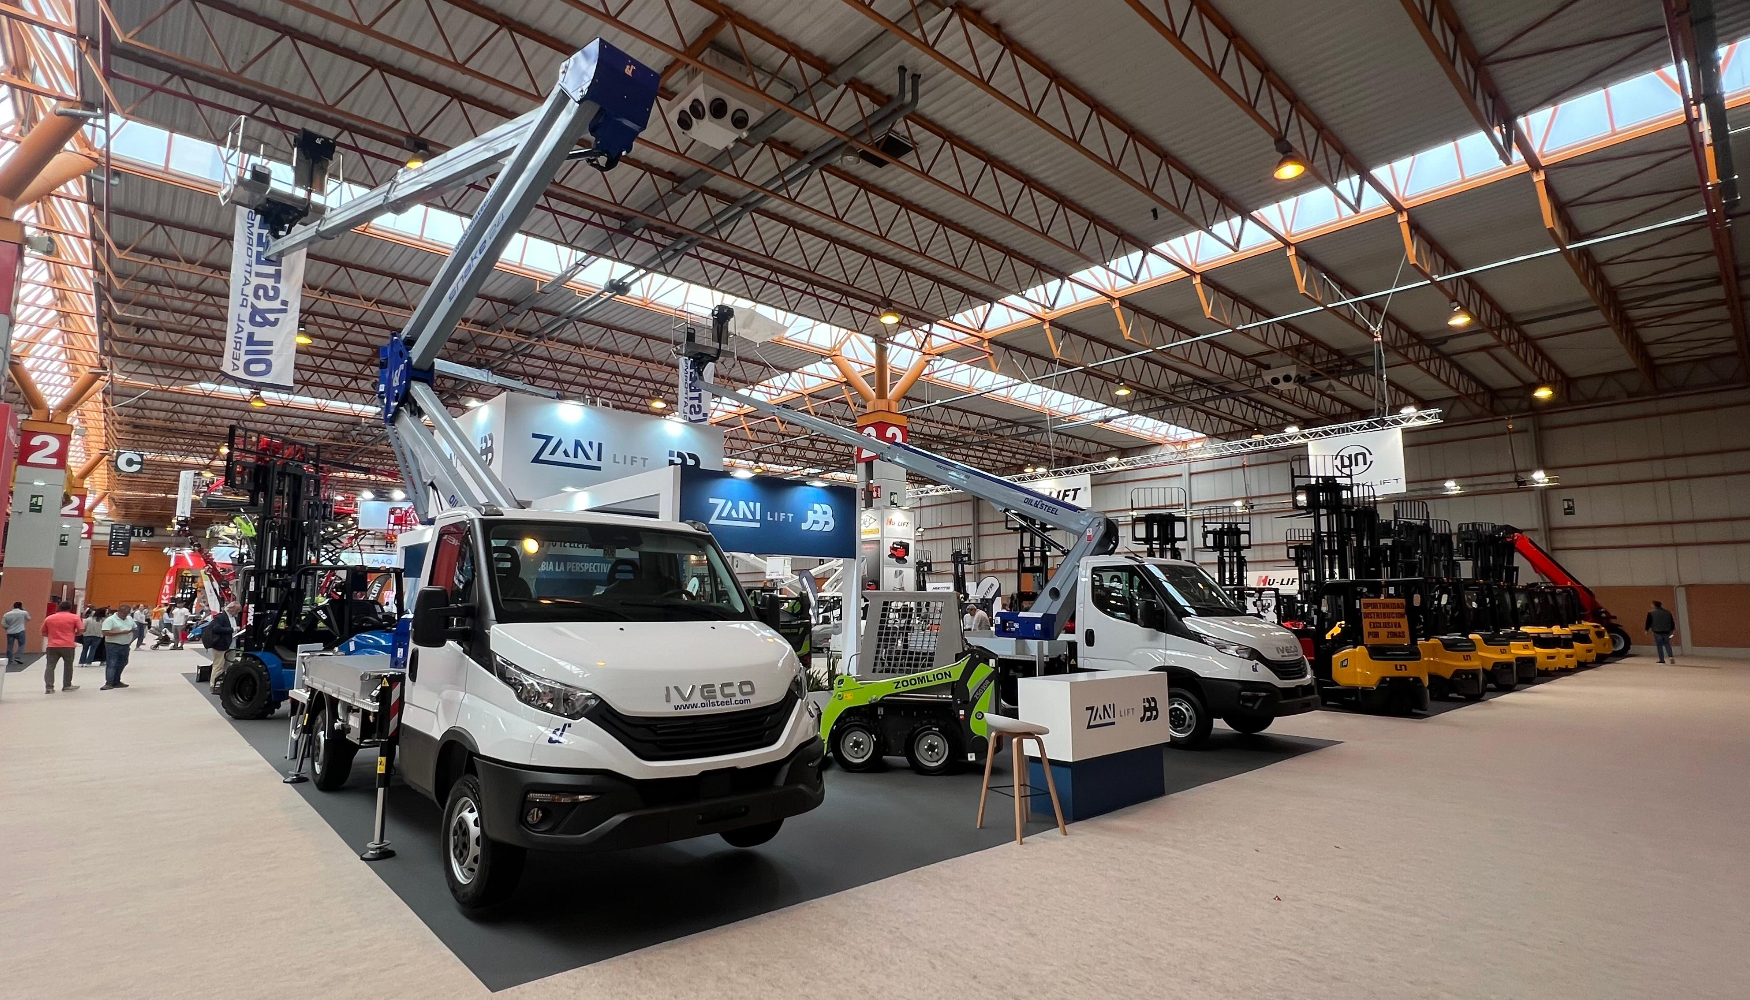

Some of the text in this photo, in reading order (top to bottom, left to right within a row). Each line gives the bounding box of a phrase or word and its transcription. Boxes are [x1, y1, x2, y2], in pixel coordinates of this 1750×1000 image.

[27, 434, 60, 465] 2
[530, 432, 603, 471] ZANI
[612, 453, 649, 468] LIFT
[117, 452, 142, 473] C
[61, 496, 81, 515] 2
[708, 498, 761, 528] ZANI
[767, 511, 794, 523] LIFT
[133, 528, 144, 537] 11
[555, 562, 565, 573] LA
[161, 575, 174, 604] KPC
[1256, 575, 1298, 587] HU-LIF
[1362, 602, 1405, 610] OPORTUNIDAD
[1369, 621, 1402, 629] EXCLUSIVA
[1367, 631, 1406, 639] POR ZONAS
[894, 670, 952, 690] ZOOMLION
[665, 680, 756, 703] IVECO
[673, 698, 751, 711] www.oilsteel.com
[1085, 703, 1116, 730] ZANI
[1119, 707, 1135, 718] LIFT
